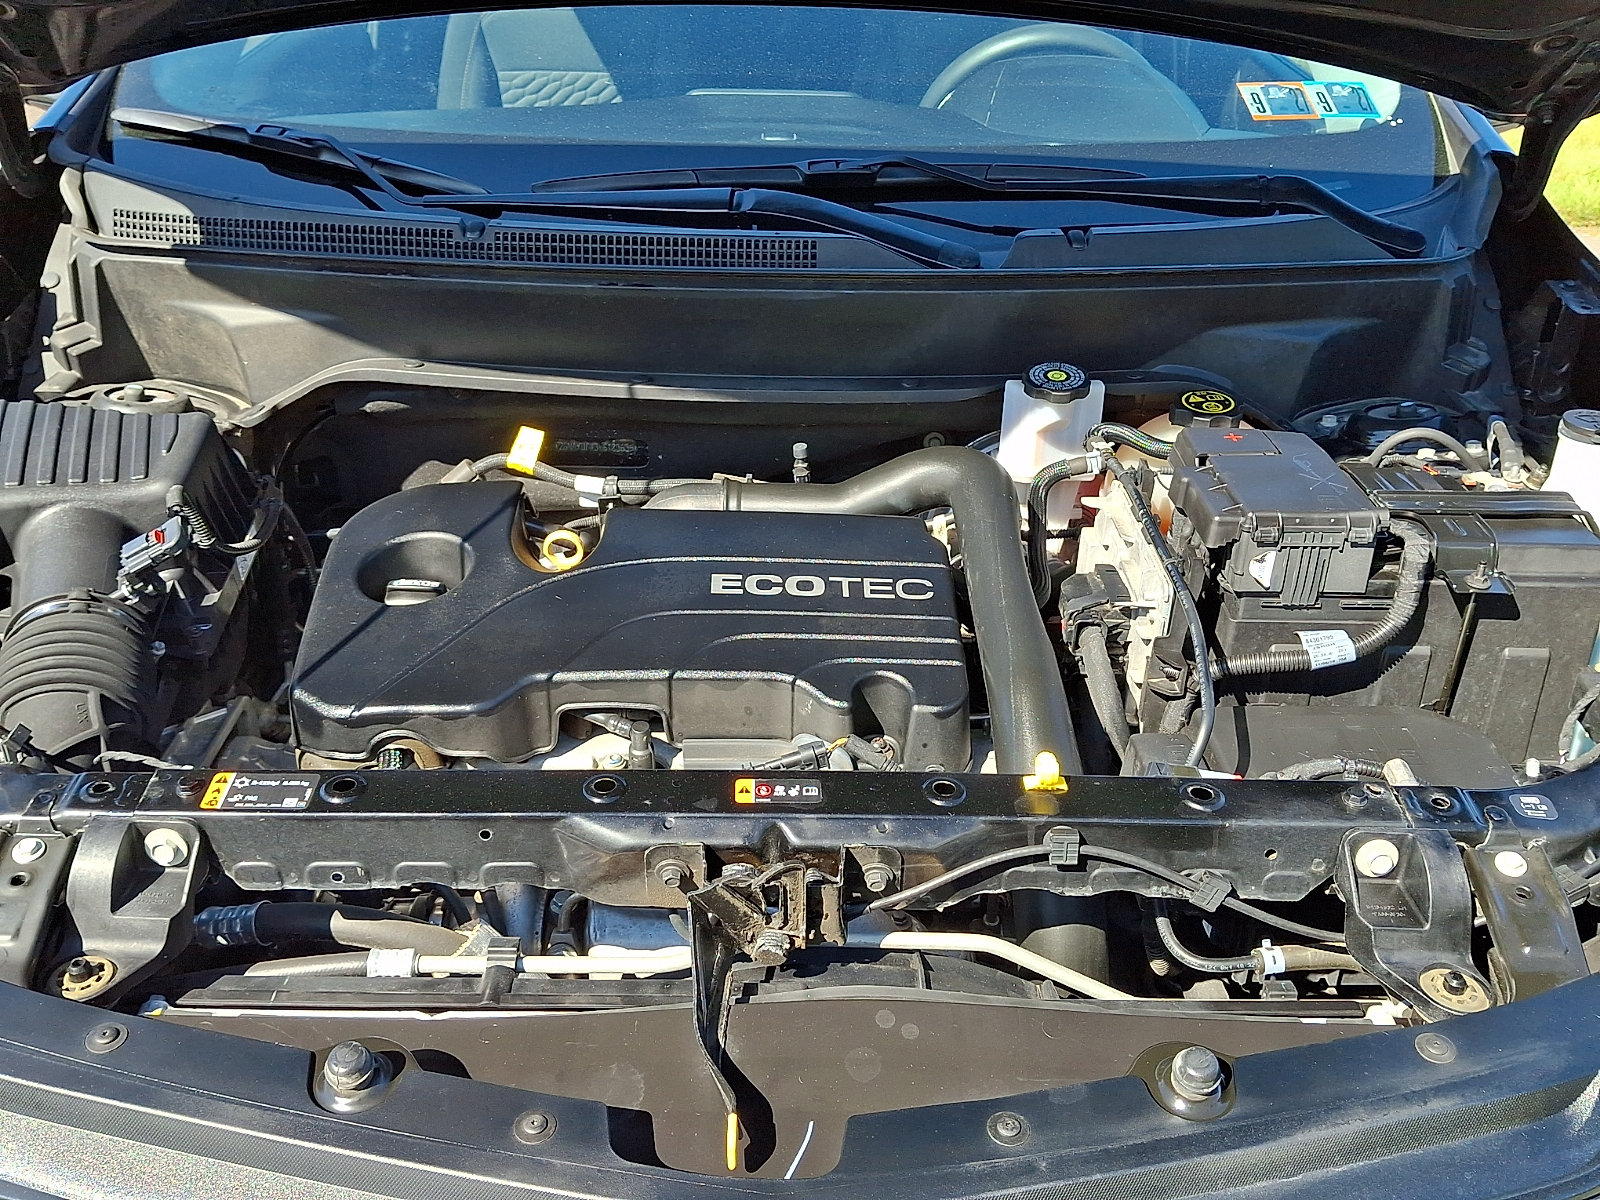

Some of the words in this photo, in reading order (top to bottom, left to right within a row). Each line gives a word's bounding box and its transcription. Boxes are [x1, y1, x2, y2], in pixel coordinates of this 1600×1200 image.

[1250, 92, 1267, 113] 9
[1316, 91, 1333, 113] 9
[710, 573, 935, 600] ECOTEC
